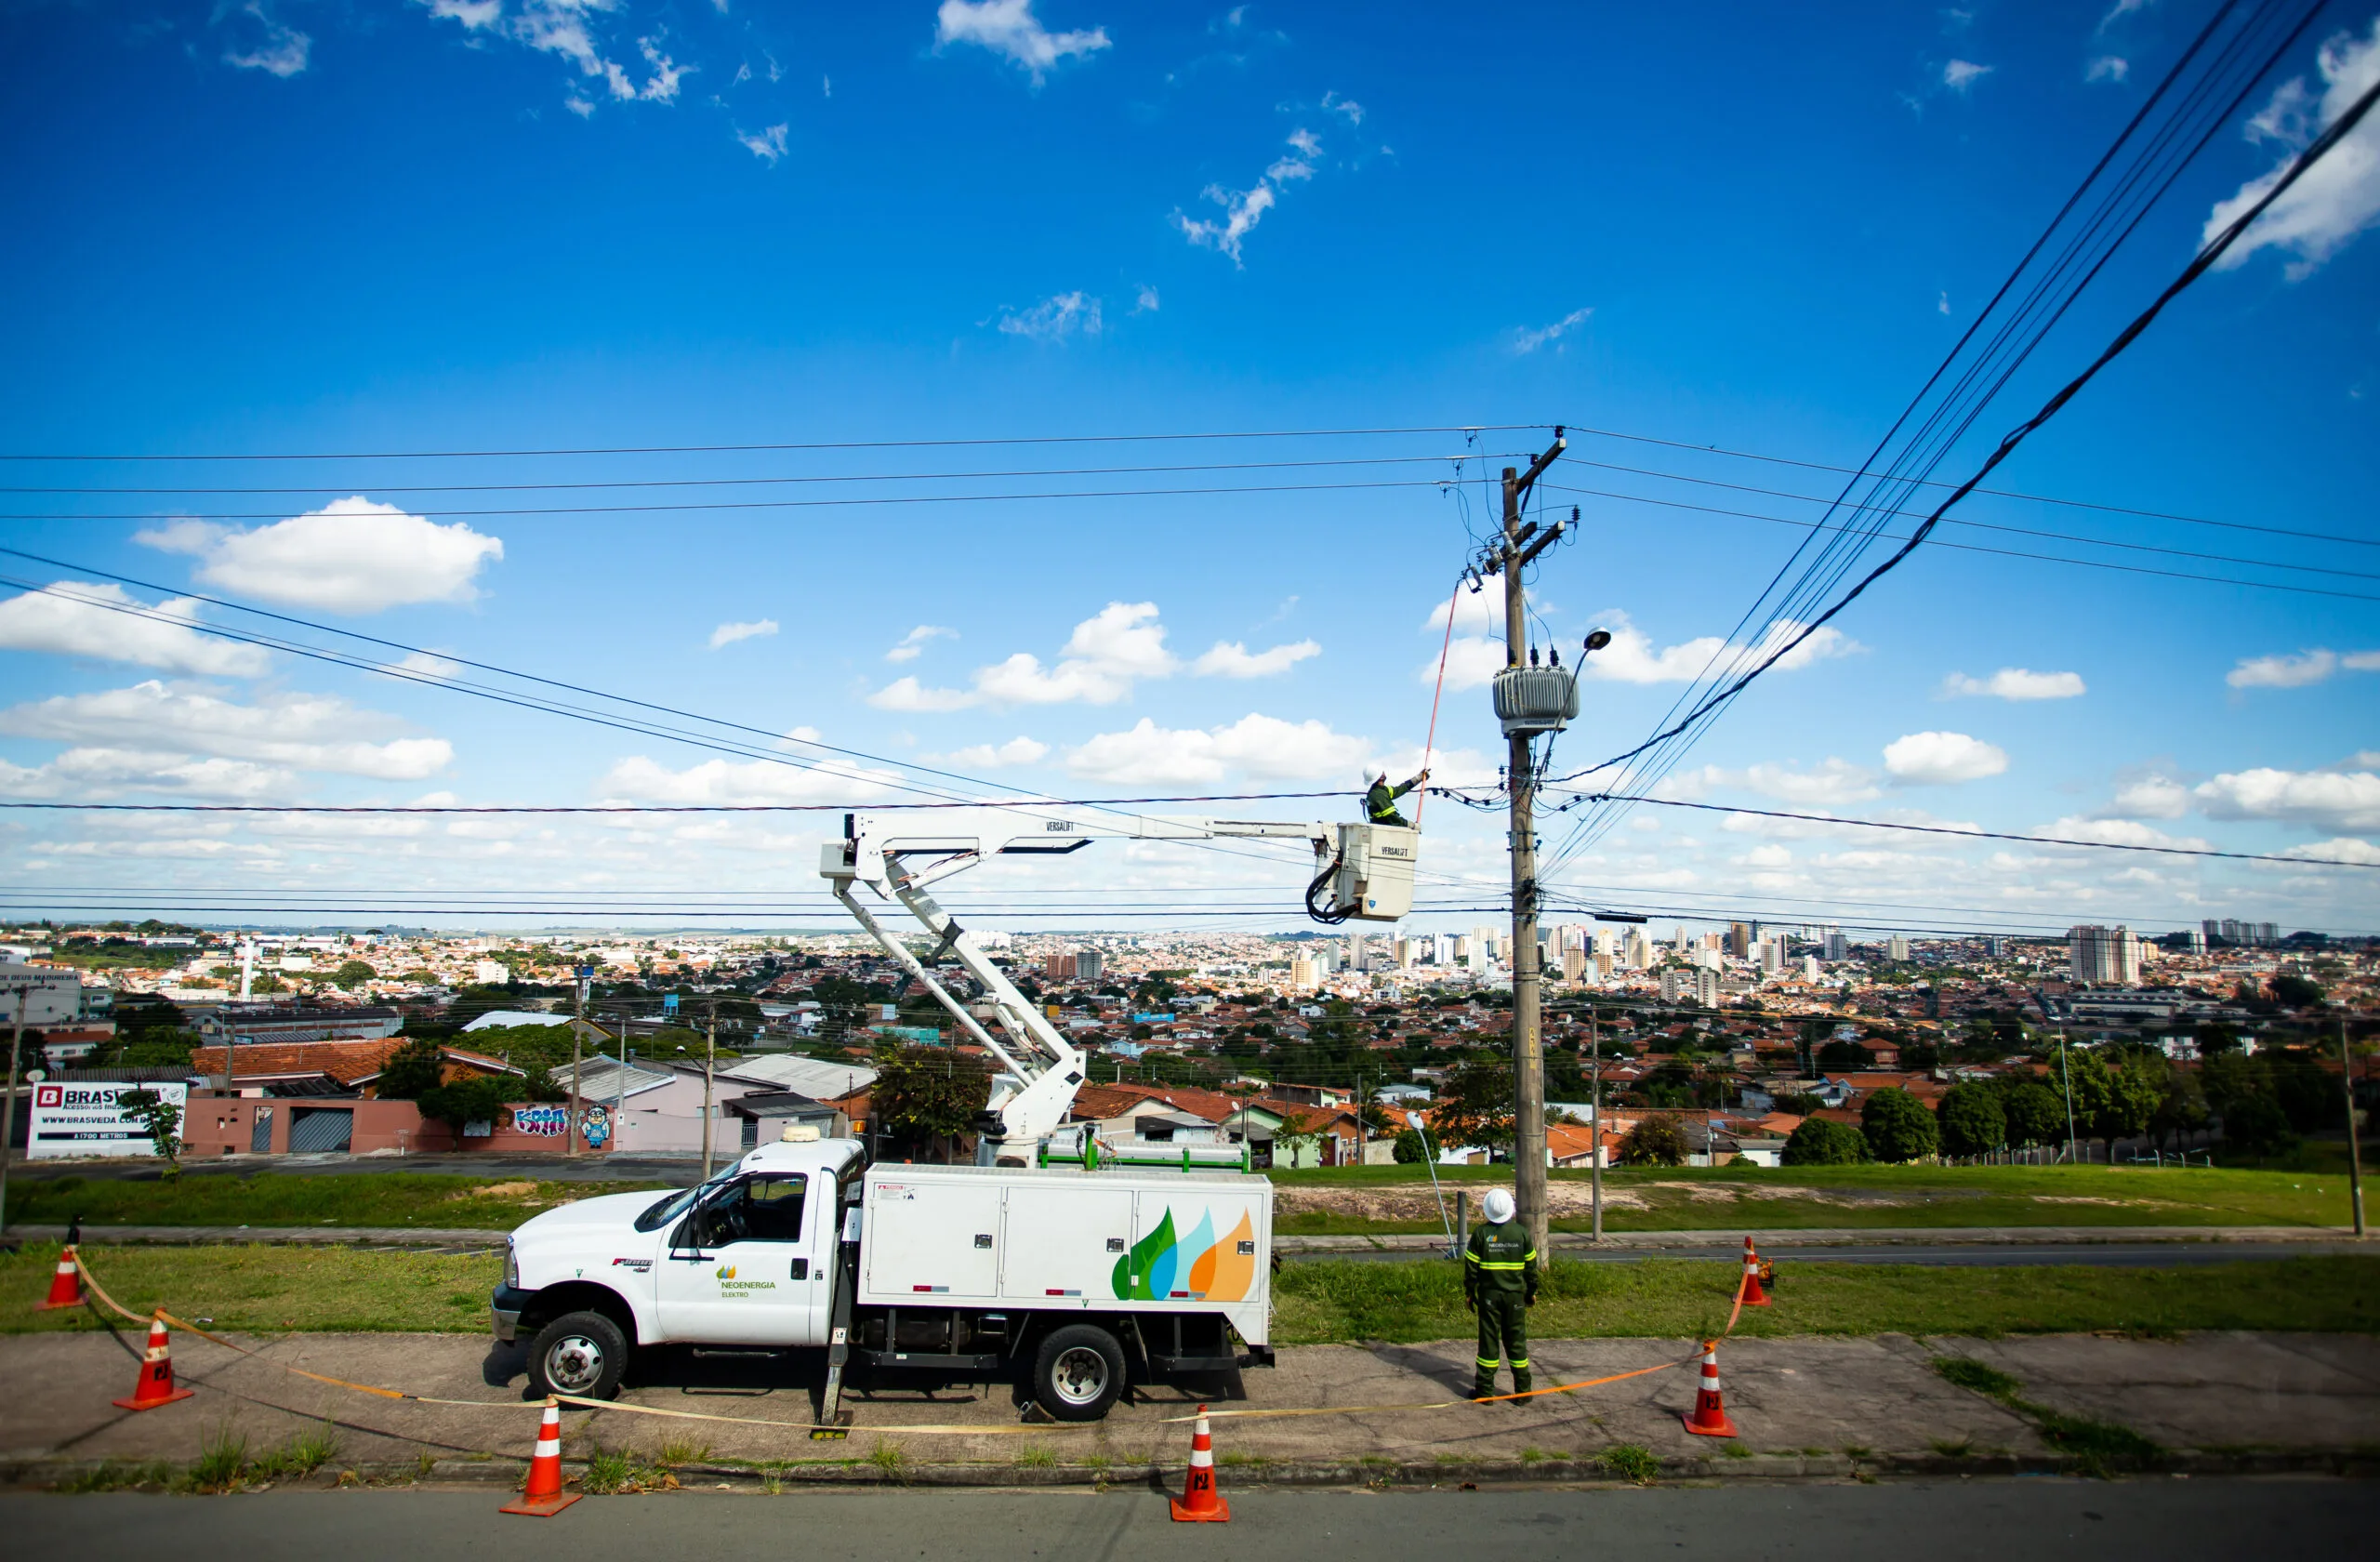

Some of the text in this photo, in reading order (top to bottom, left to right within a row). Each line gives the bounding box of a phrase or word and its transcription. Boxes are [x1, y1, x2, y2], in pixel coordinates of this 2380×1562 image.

[1046, 821, 1074, 832] VERSALIFT
[1382, 846, 1408, 857] VERSALIFT
[721, 1281, 775, 1290] NEOENERGIA
